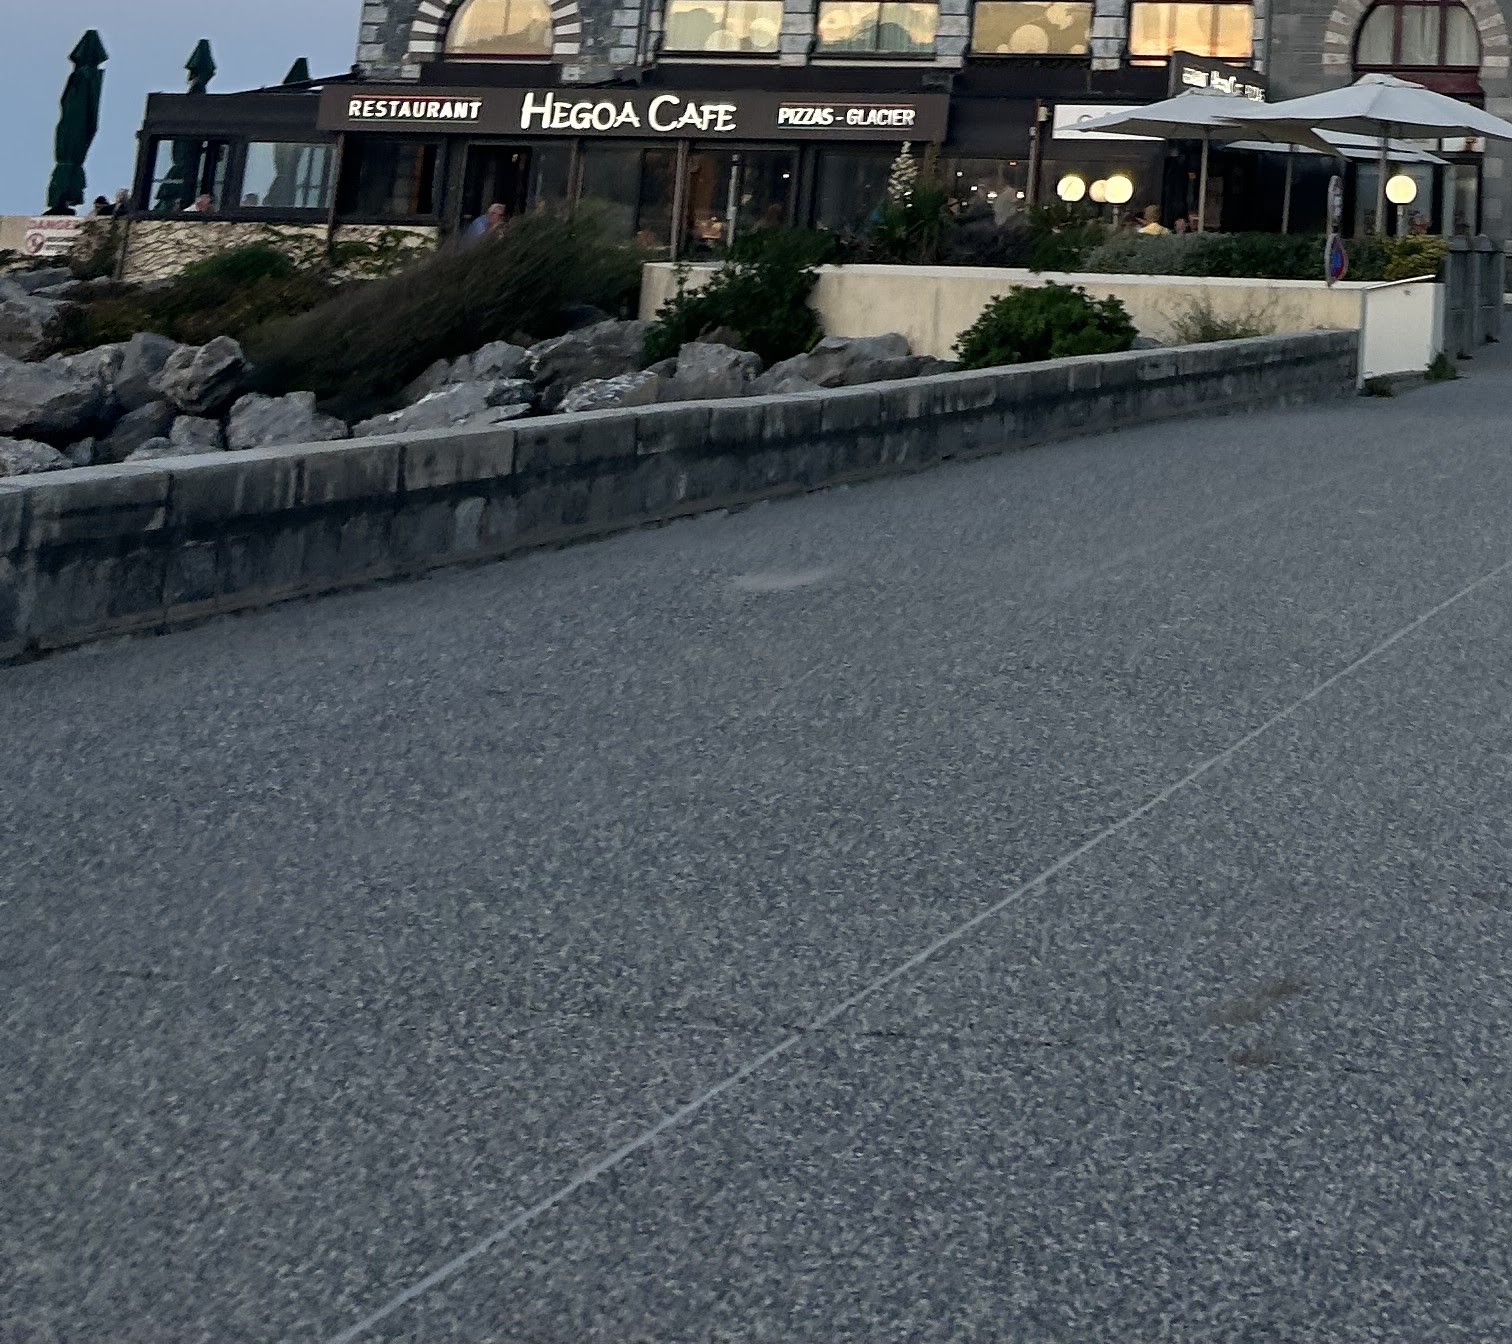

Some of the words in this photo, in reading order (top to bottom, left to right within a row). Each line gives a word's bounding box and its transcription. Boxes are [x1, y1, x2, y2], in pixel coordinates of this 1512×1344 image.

[348, 99, 482, 119] RESTAURANT
[520, 91, 641, 131] HEGOA
[649, 94, 737, 132] CAFE
[777, 107, 834, 125] PIZZAS
[846, 108, 916, 126] GLACIER
